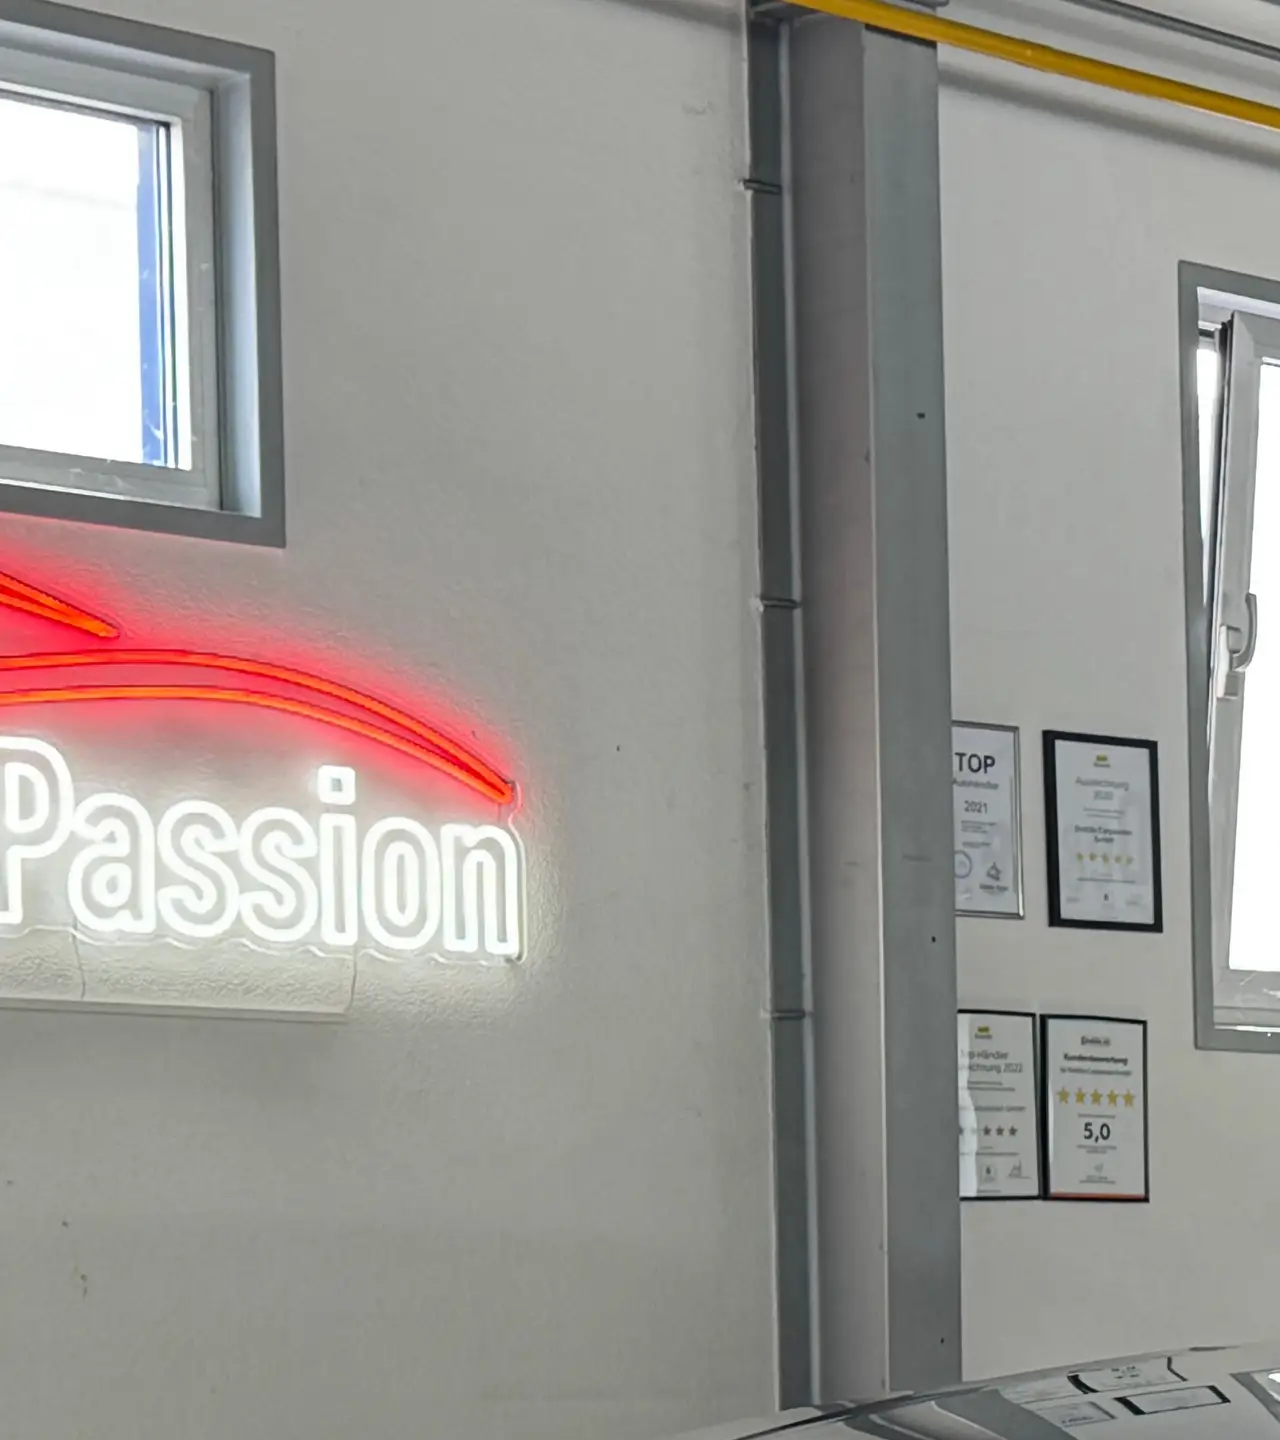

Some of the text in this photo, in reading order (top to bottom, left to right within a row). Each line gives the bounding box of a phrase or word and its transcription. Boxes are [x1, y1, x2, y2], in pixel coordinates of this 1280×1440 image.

[954, 752, 996, 774] TOP
[0, 735, 521, 955] Passion
[1083, 1122, 1111, 1143] 5,0
